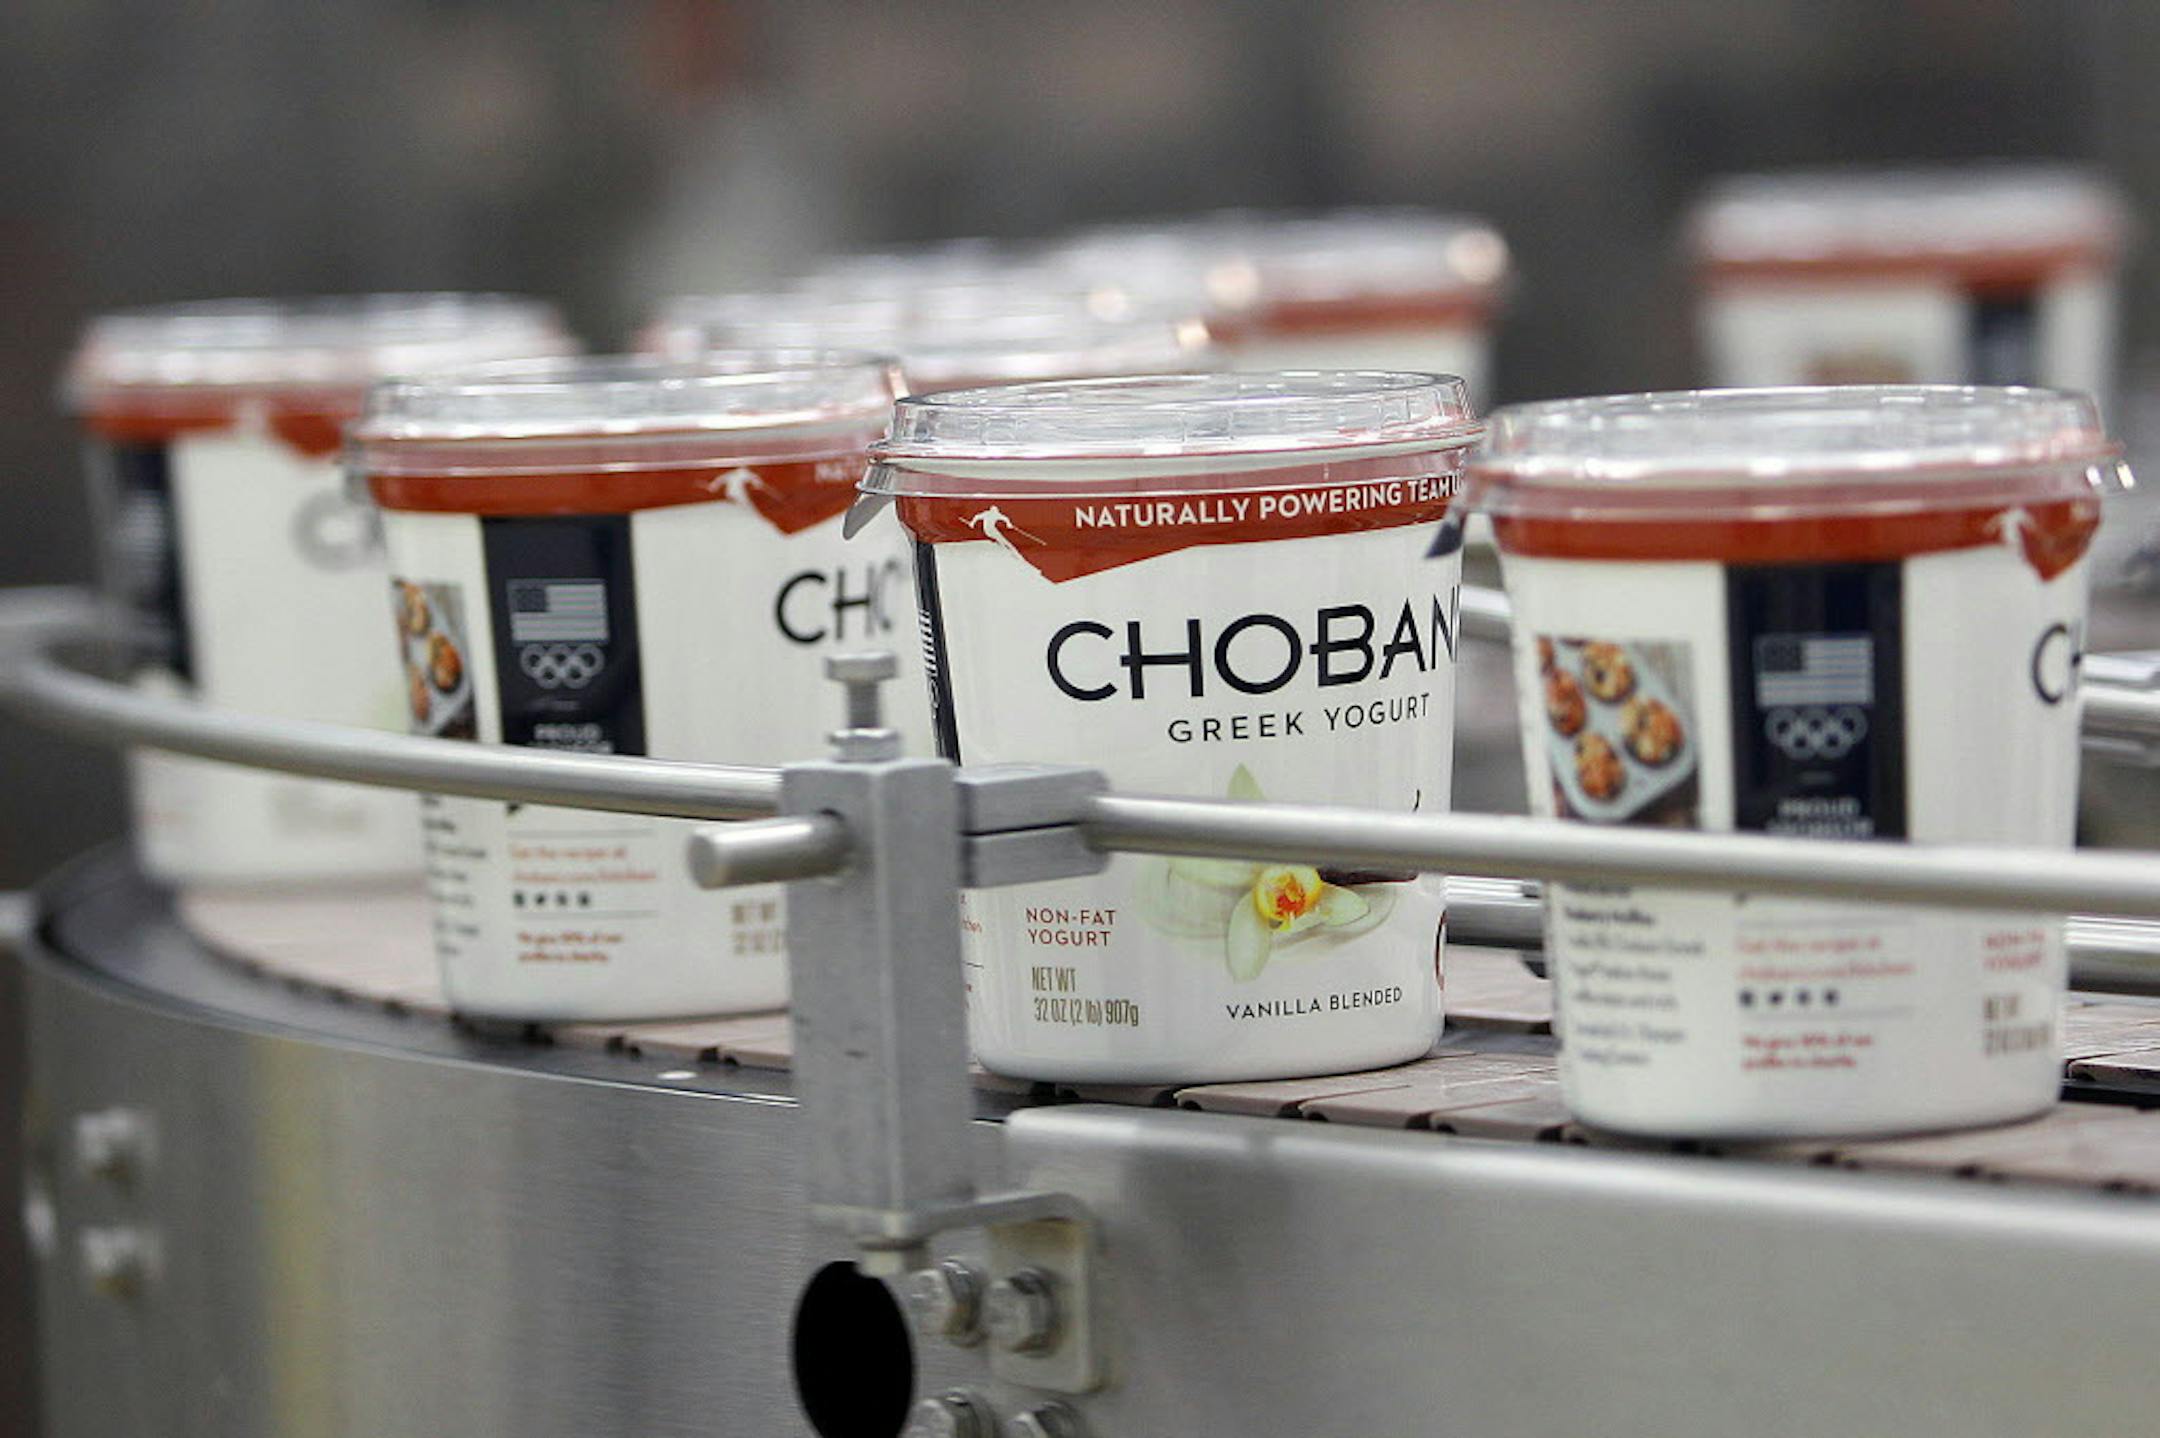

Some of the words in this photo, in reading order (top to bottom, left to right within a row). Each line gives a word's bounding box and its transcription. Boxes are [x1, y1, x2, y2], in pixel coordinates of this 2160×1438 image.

[1074, 498, 1250, 529] NATURALLY
[1259, 481, 1403, 520] POWERING
[1168, 712, 1304, 744] GREEK
[1323, 692, 1431, 732] YOGURT
[1025, 907, 1117, 925] NON-FAT
[1027, 928, 1112, 947] YOGURT
[1031, 966, 1053, 992] NET
[1055, 967, 1076, 993] WT
[1033, 997, 1049, 1022] 32
[1051, 998, 1068, 1023] OZ
[1105, 999, 1140, 1027] 907g
[1225, 998, 1323, 1020] VANILLA
[1330, 986, 1404, 1011] BLENDED
